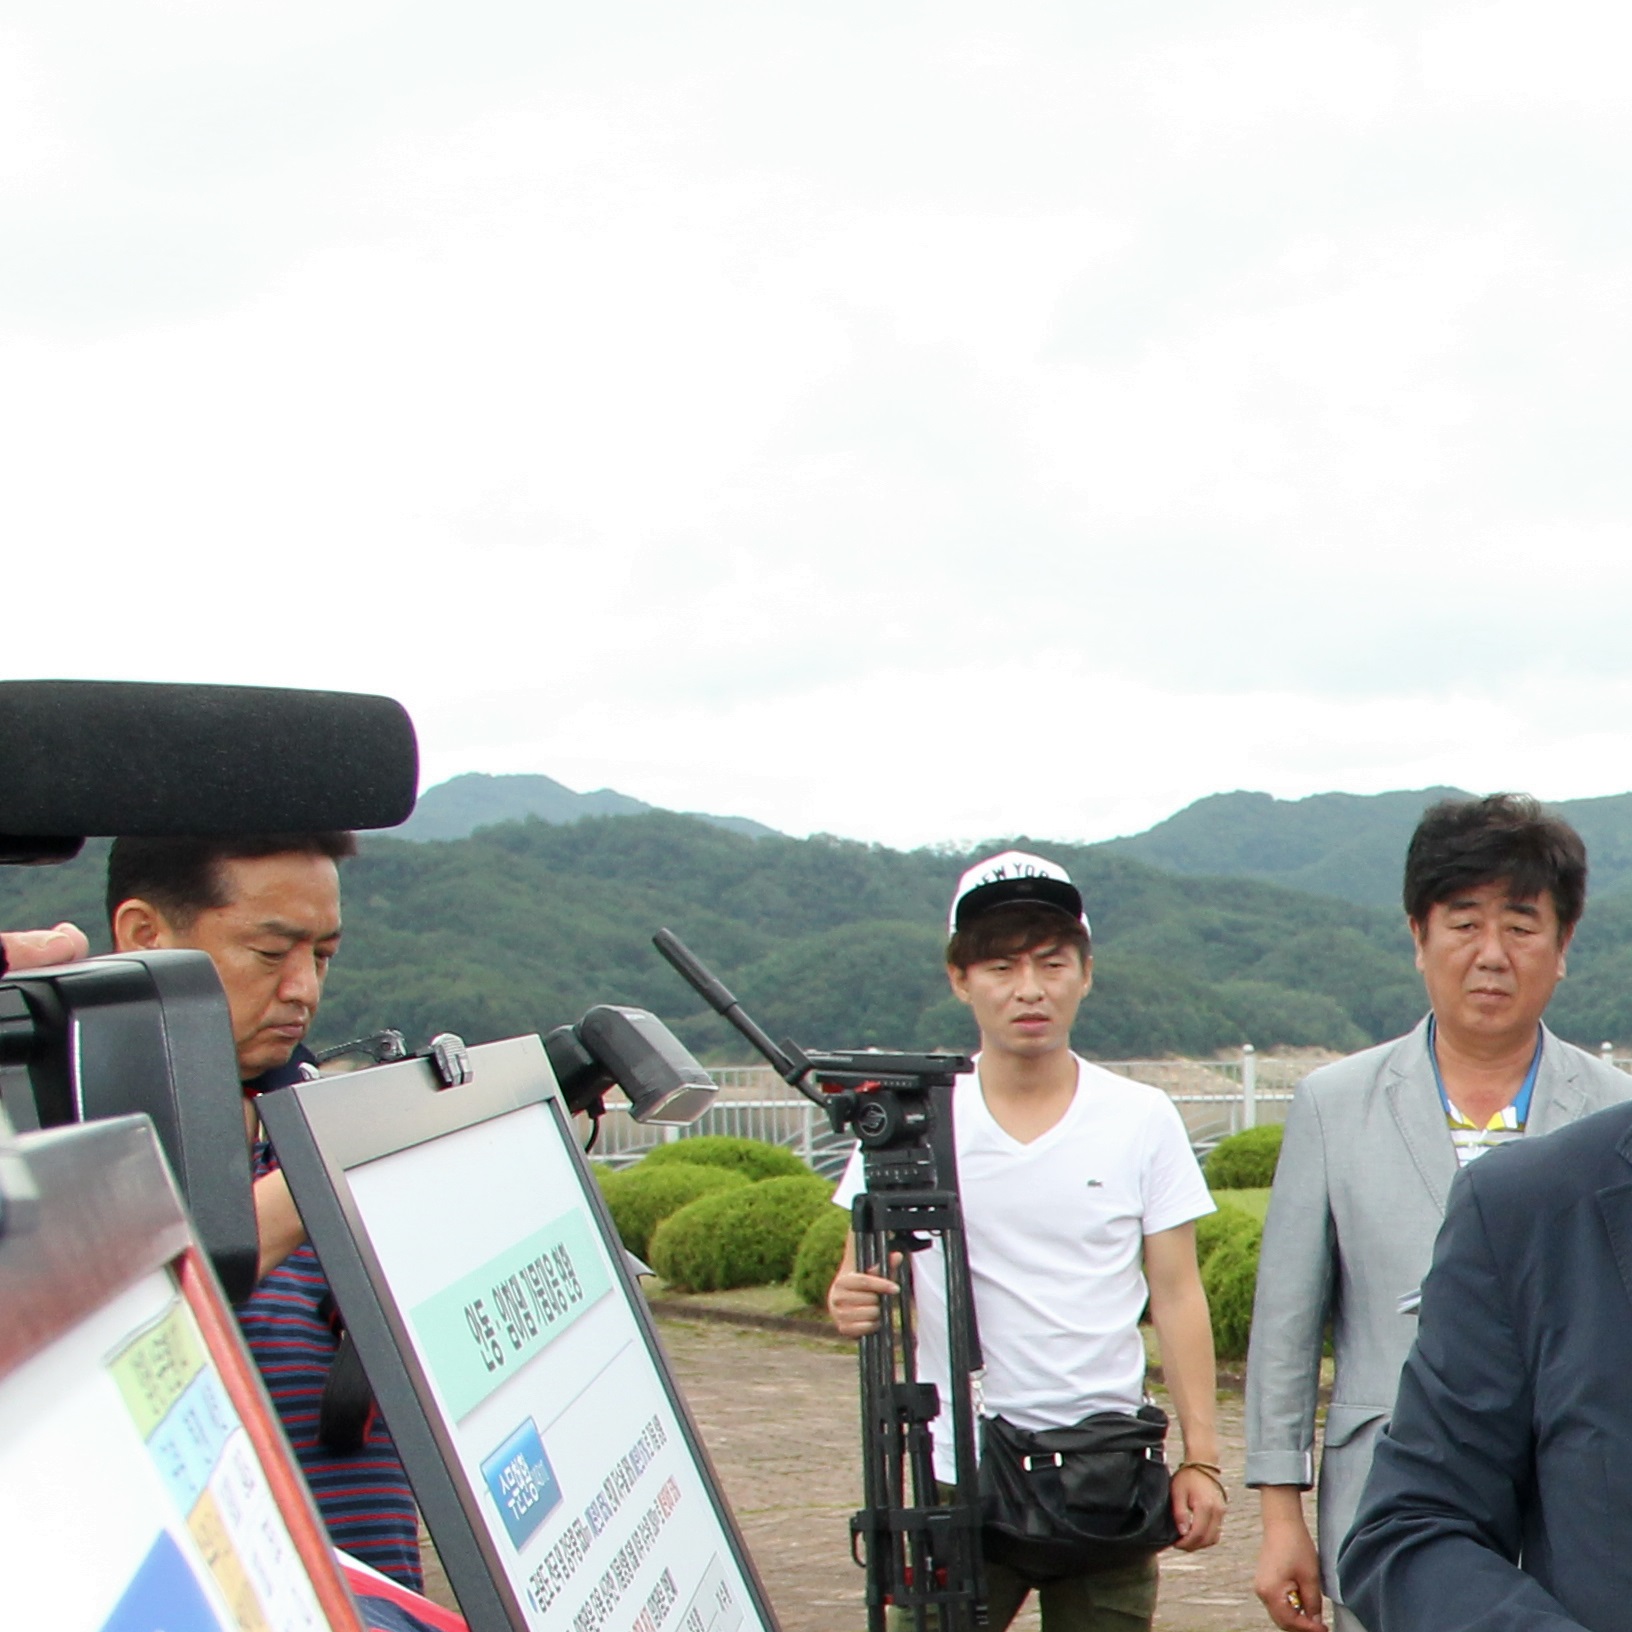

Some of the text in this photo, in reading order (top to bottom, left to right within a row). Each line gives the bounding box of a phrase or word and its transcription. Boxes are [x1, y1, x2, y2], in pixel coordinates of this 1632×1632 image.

[464, 1243, 583, 1372] 안동 임하댐 가뭄대응 현황
[498, 1452, 539, 1520] 수문현황
